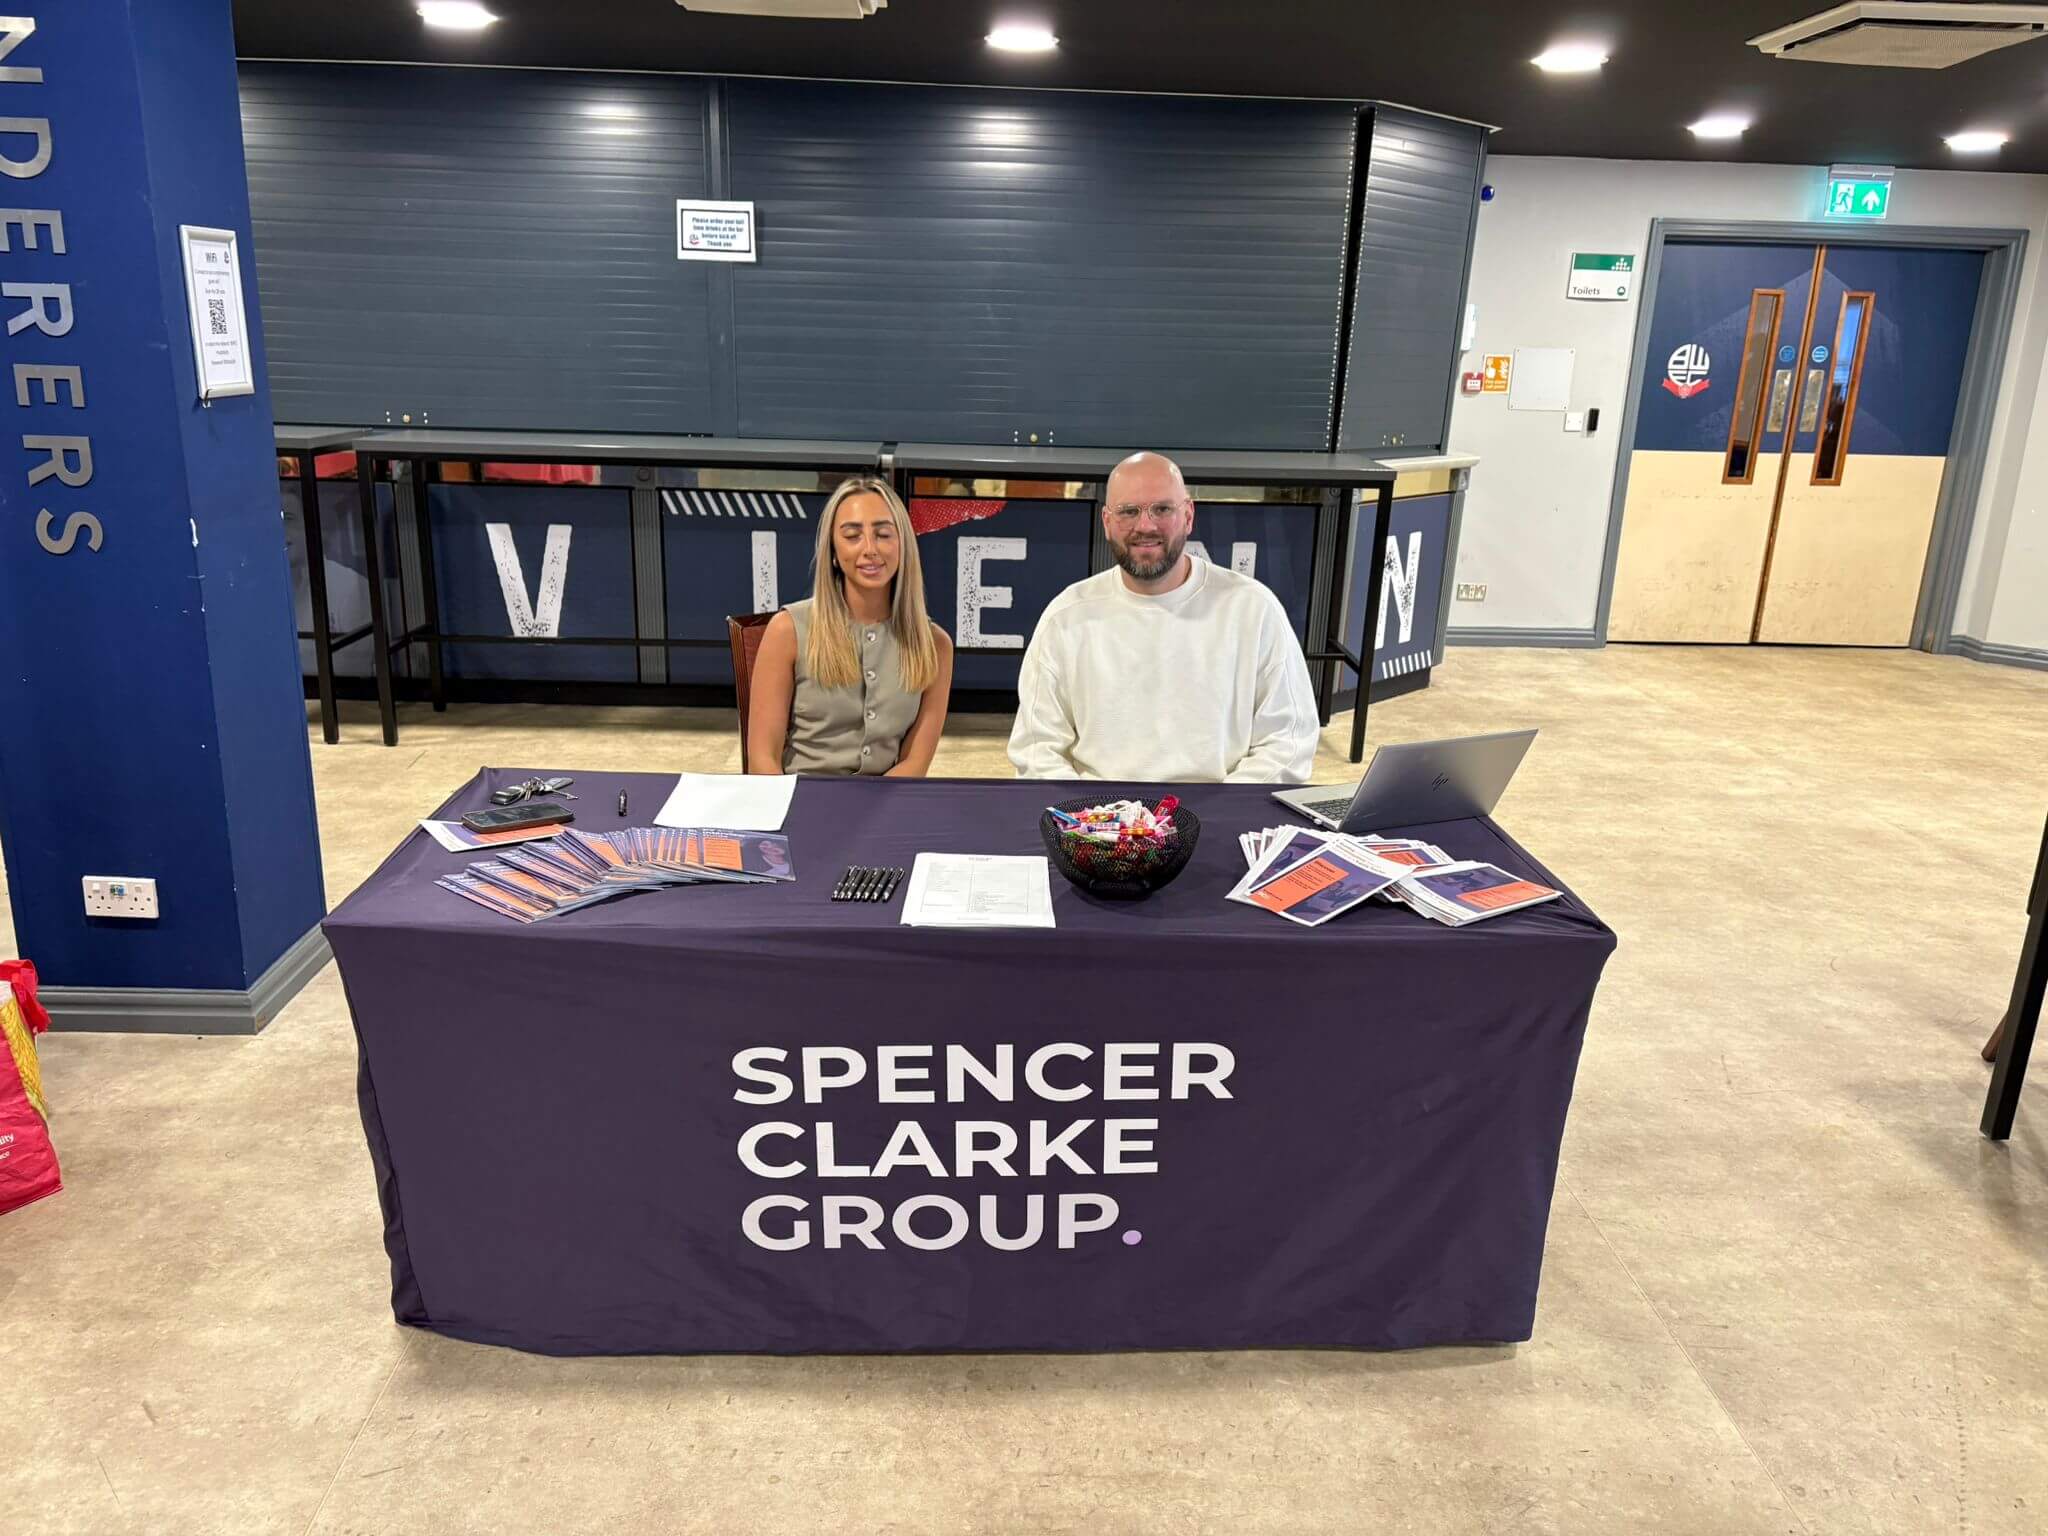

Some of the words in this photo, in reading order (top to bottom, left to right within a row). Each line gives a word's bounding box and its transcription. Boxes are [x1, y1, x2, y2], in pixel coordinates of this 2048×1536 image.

[1572, 286, 1600, 295] Toilets
[731, 1042, 1236, 1104] SPENCER
[737, 1118, 1159, 1179] CLARKE
